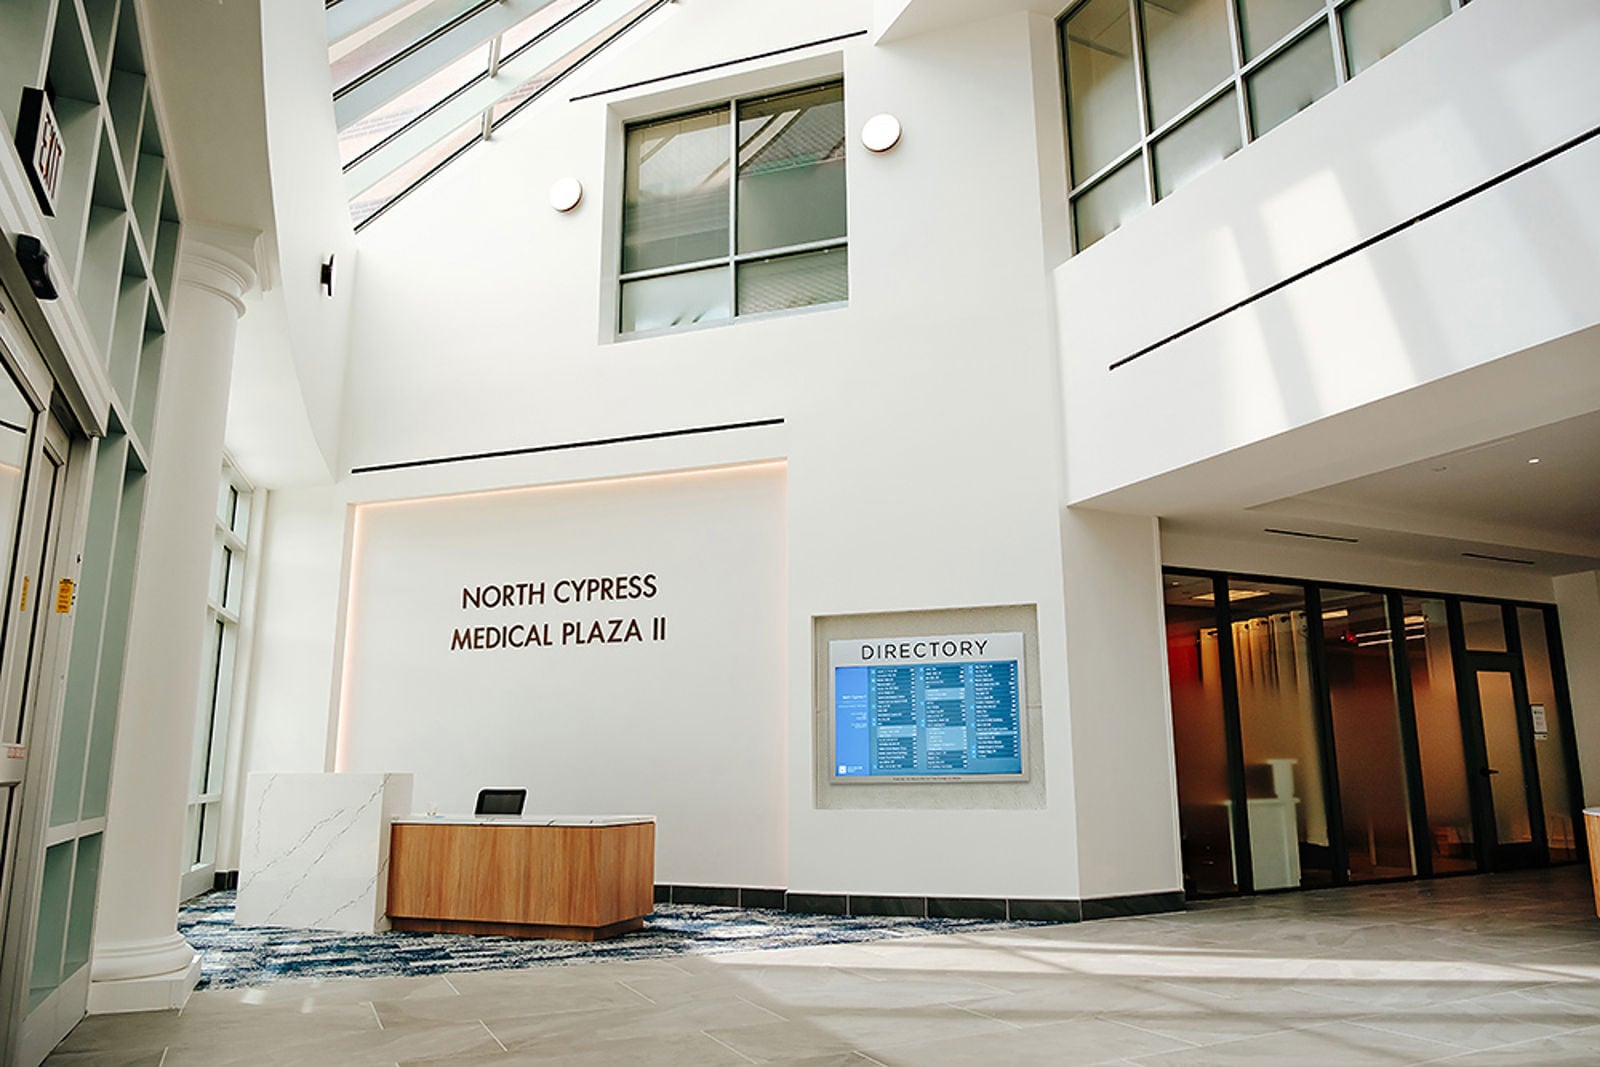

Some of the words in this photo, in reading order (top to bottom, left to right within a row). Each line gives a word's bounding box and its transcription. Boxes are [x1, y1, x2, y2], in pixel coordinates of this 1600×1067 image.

[38, 112, 62, 199] EXIT
[462, 582, 545, 609] NORTH
[553, 574, 657, 604] CYPRESS
[450, 624, 553, 651] MEDICAL
[562, 618, 643, 646] PLAZA
[653, 616, 666, 641] II
[861, 640, 988, 660] DIRECTORY
